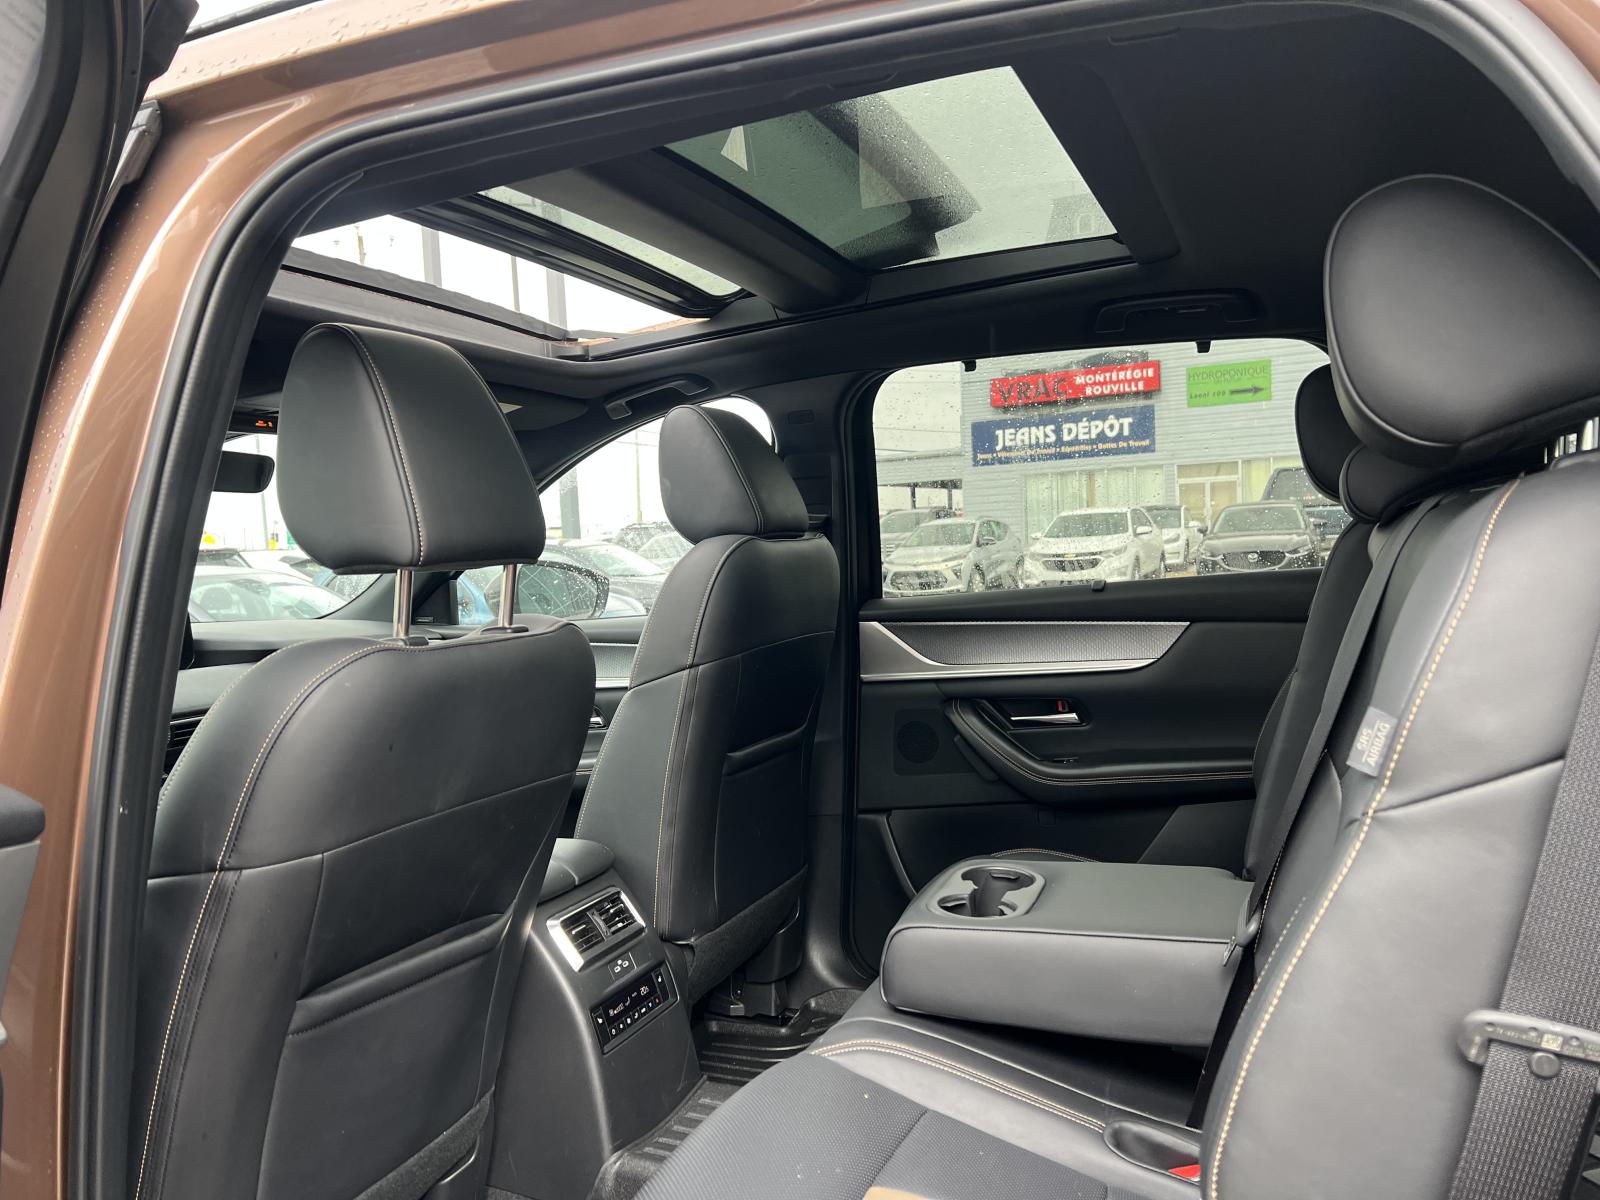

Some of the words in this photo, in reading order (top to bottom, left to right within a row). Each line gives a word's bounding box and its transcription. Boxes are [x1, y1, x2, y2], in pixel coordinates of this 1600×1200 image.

[1074, 367, 1155, 385] MONTÉRÉGIE
[1188, 366, 1267, 382] HYDROPONIQUE
[998, 378, 1068, 401] VRAC
[1085, 380, 1145, 395] ROUVILLE
[995, 425, 1056, 451] JEANS
[1062, 415, 1133, 442] DÉPÔT
[1366, 722, 1391, 767] AIRBAG
